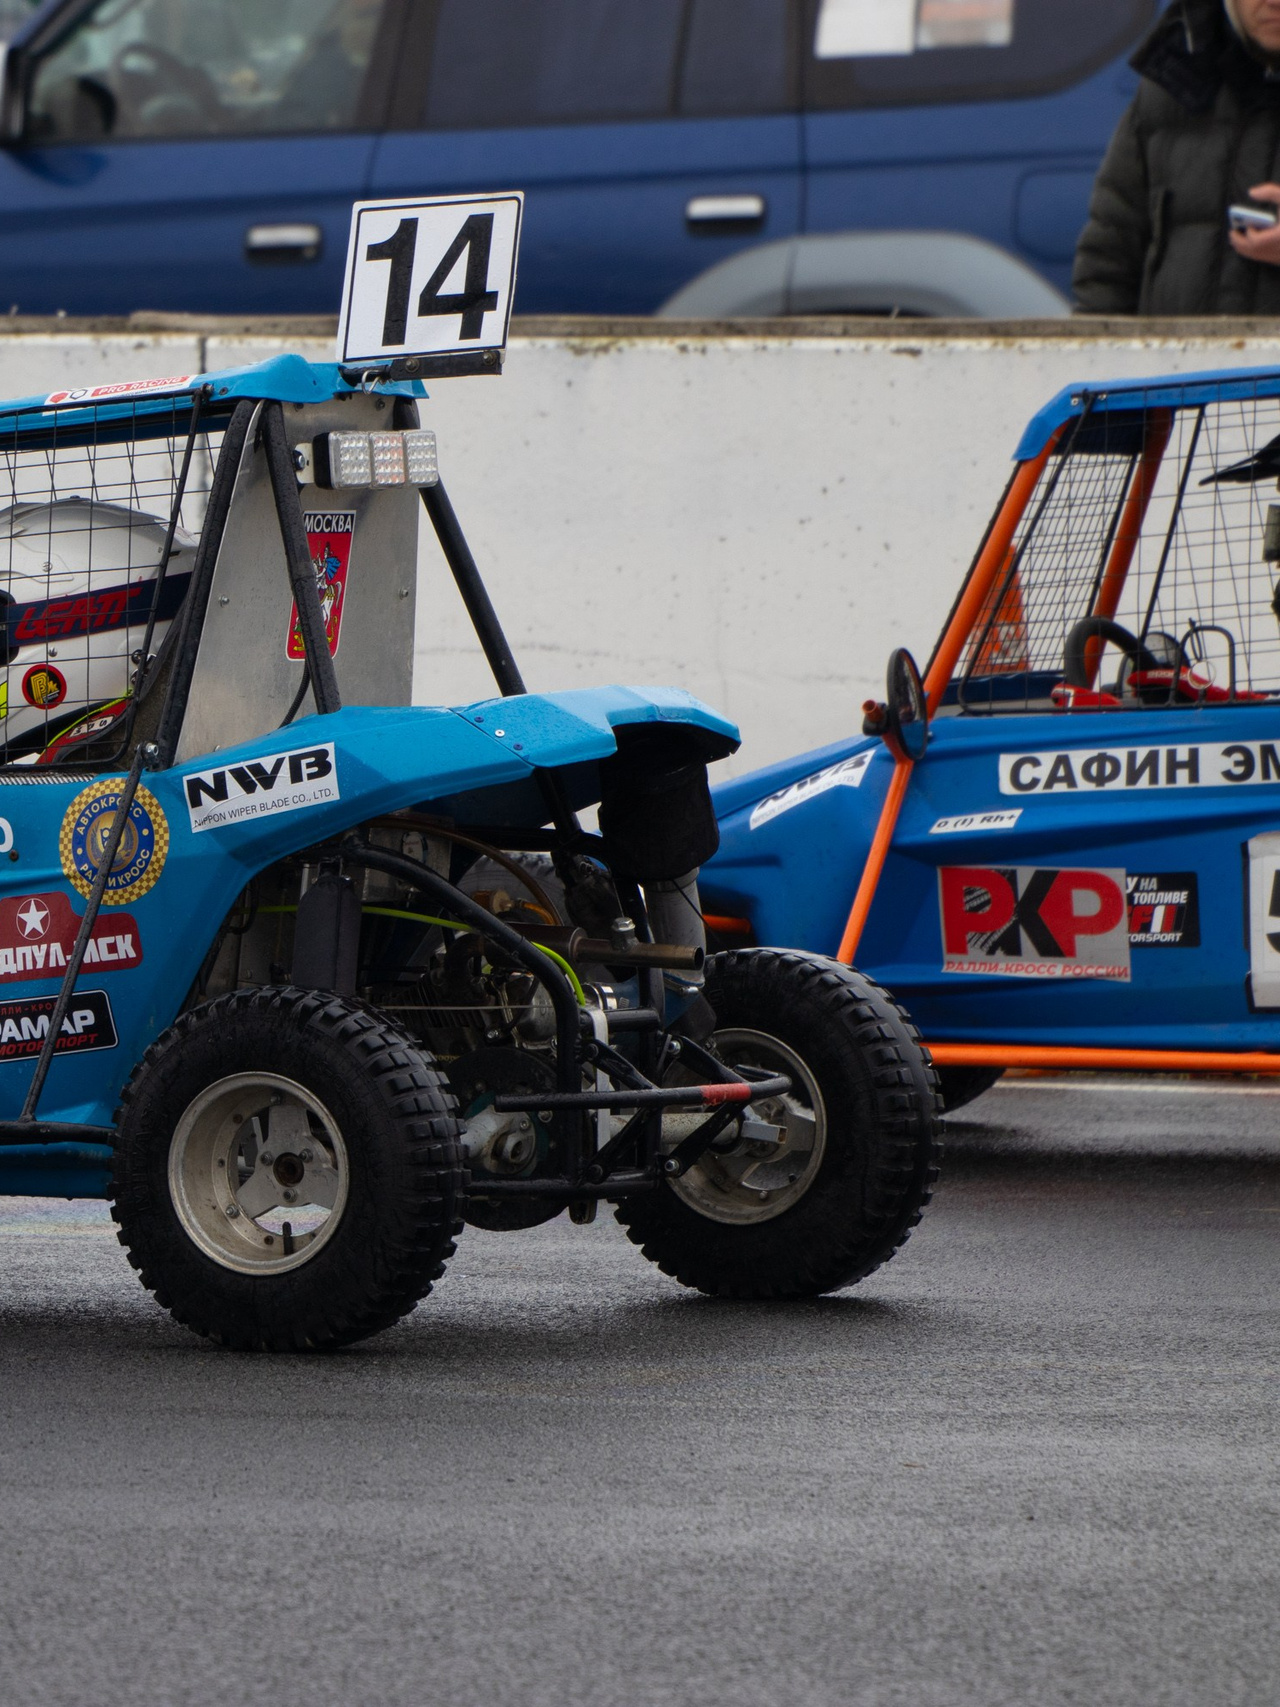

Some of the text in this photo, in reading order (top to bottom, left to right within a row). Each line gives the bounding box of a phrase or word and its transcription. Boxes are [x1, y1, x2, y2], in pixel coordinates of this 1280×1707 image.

[366, 212, 499, 347] 14
[98, 385, 127, 395] PRO
[129, 377, 182, 390] RACING
[304, 514, 352, 533] МОСКВА
[186, 748, 332, 809] NWB
[1009, 747, 1200, 792] САФИН
[77, 796, 143, 835] АВТОКРС
[194, 812, 227, 828] NIPPON
[228, 804, 258, 822] WIPER
[259, 797, 290, 813] BLADE
[313, 788, 334, 801] LTD.
[980, 814, 1016, 824] Rh+
[80, 848, 150, 888] РАИКРОСС
[1139, 877, 1158, 891] НА
[1133, 890, 1189, 905] ТОПЛИВЕ
[1128, 932, 1183, 943] ORSPORT
[945, 960, 1129, 979] РАЛЛИ-КРОСС РОССИИ
